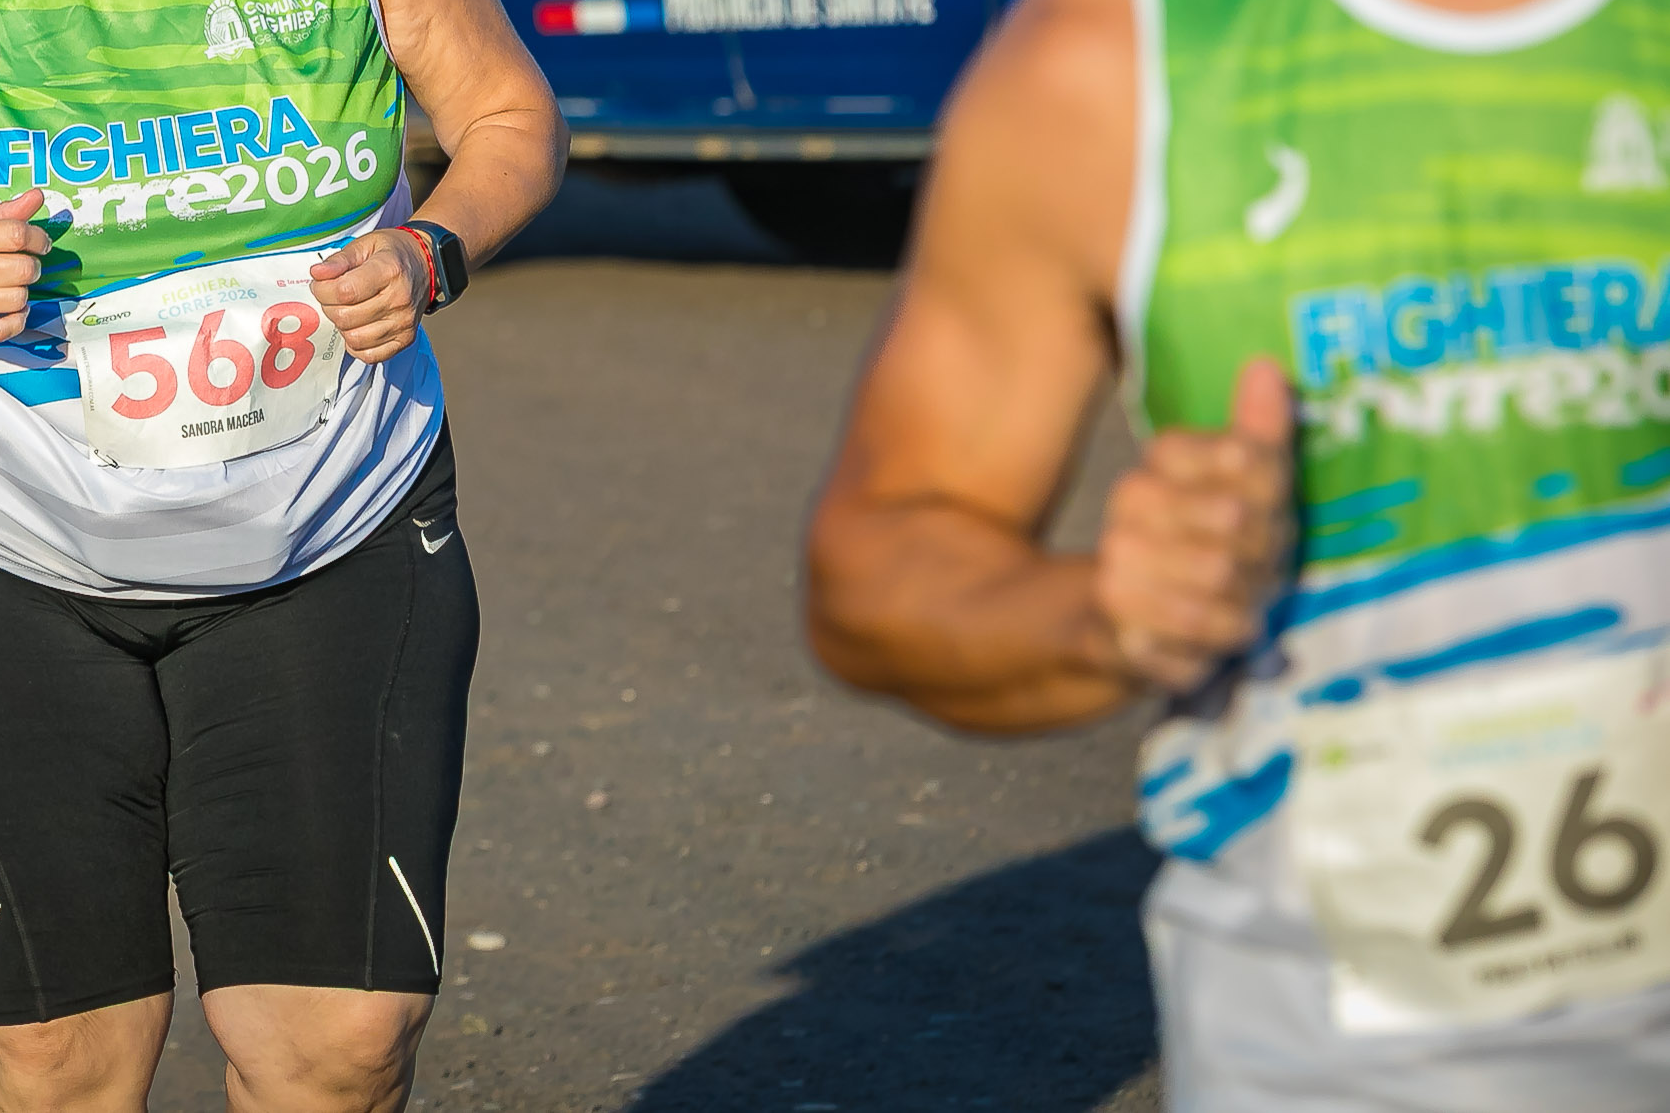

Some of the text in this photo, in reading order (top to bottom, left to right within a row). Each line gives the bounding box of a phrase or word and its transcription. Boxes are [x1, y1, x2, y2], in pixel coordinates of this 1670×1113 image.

[248, 0, 328, 35] FIGHIERA
[158, 288, 258, 320] CORRE 2026
[162, 276, 241, 305] FIGHIERA
[108, 301, 321, 420] 568
[181, 407, 265, 438] SANDRA MACERA
[1418, 763, 1659, 950] 26
